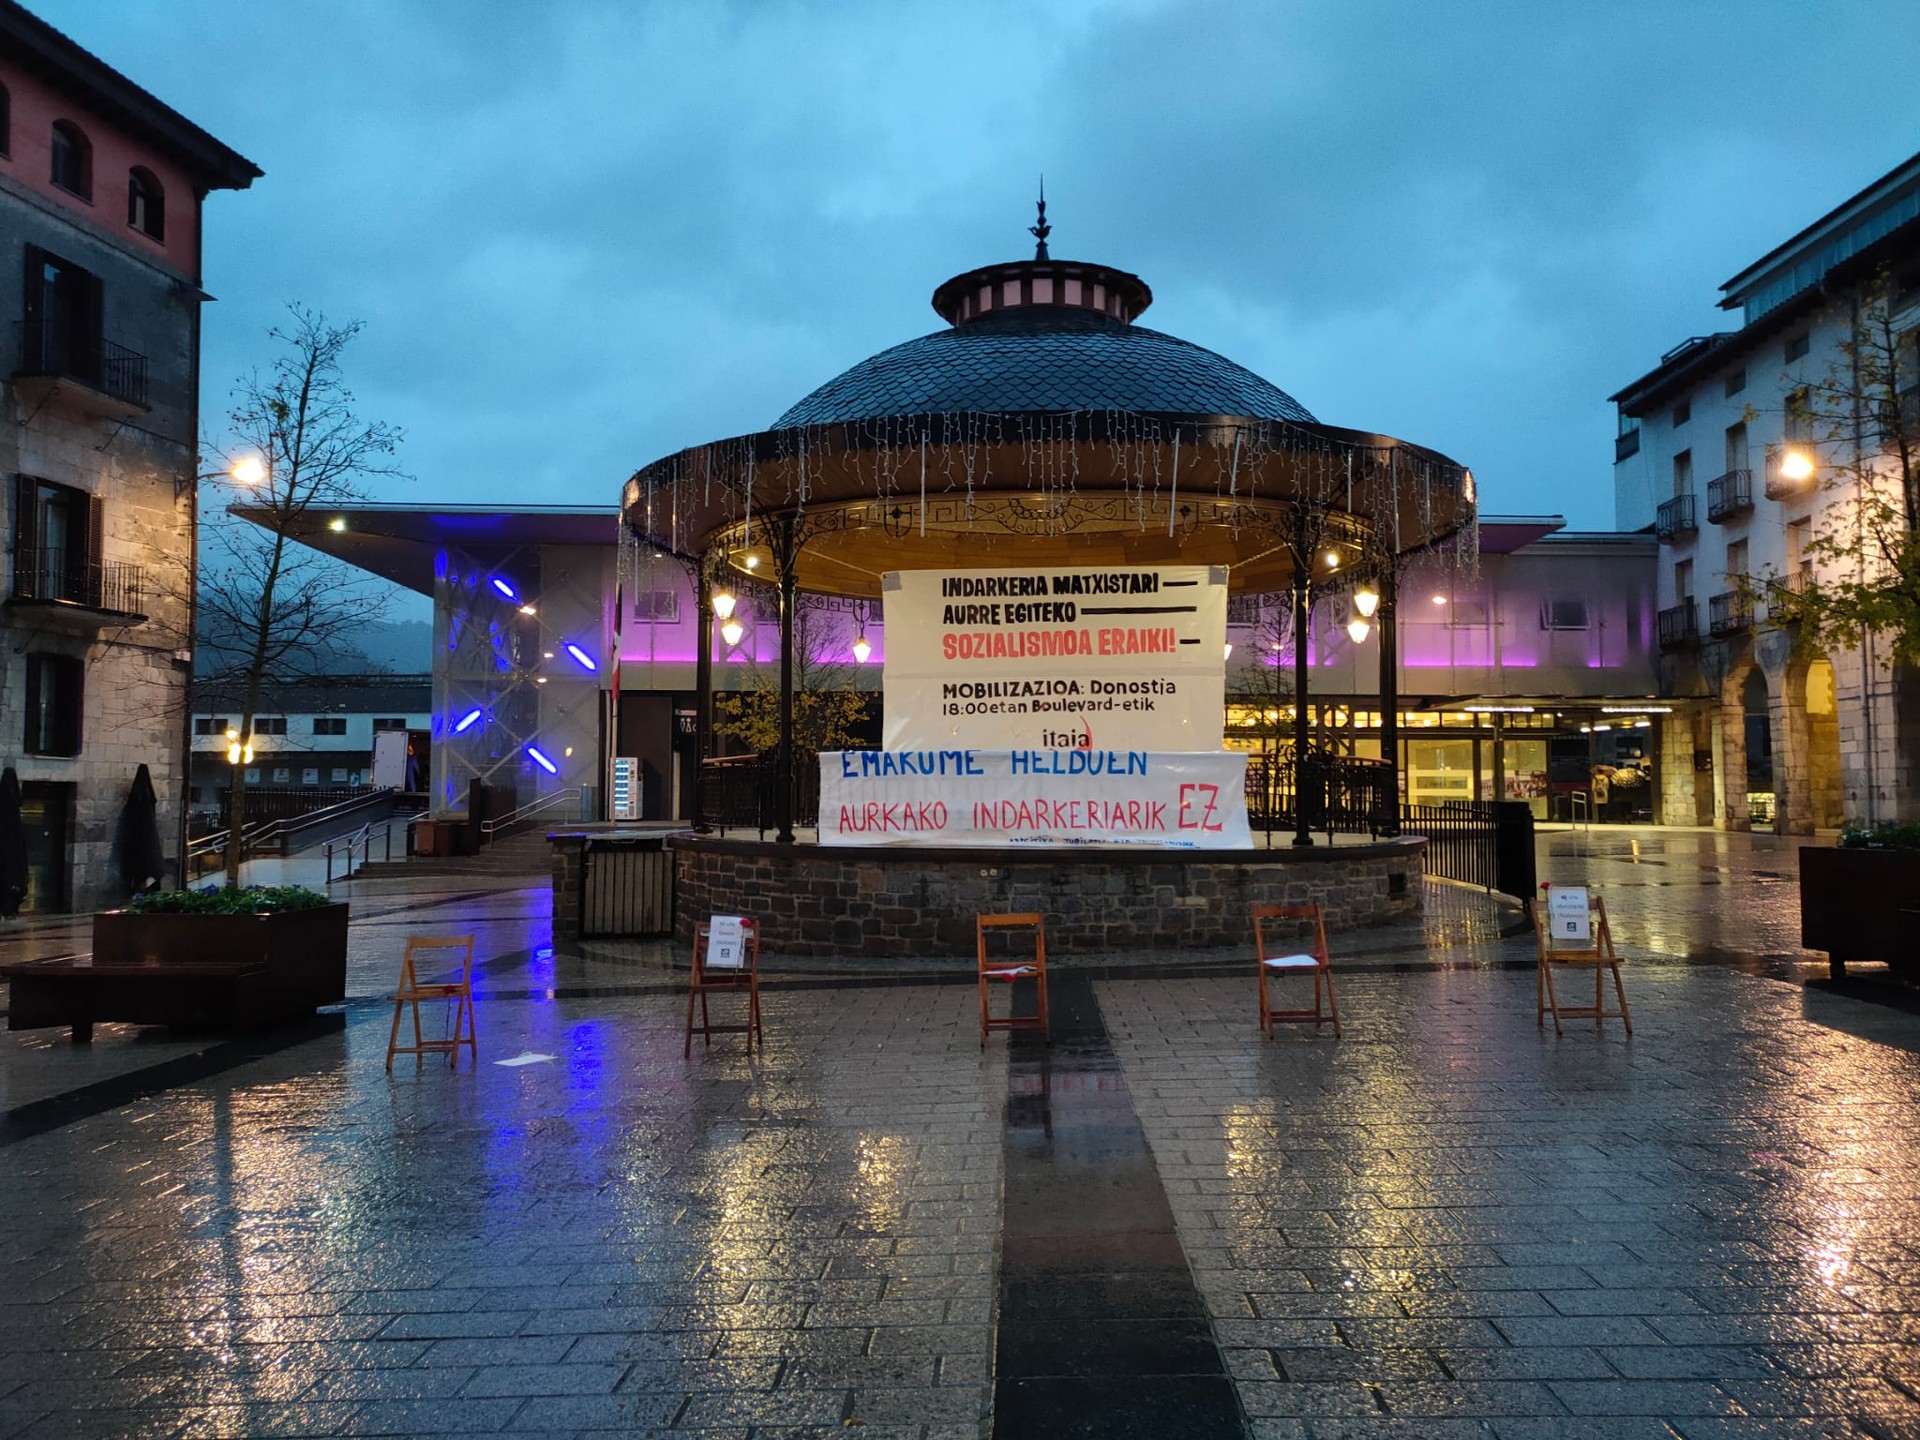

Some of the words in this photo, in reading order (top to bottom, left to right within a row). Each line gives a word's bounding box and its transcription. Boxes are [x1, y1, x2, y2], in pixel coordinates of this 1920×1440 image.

[942, 576, 1048, 598] INDARKERIA
[1052, 572, 1159, 595] MATXISTARI
[943, 603, 1000, 625] AURRE
[1005, 601, 1077, 624] EGITEKO
[942, 629, 1092, 660] SOZIALISMOA
[1098, 627, 1176, 656] ERAIKI!
[943, 679, 1085, 699] MOBILIZAZIOA:
[1090, 677, 1176, 696] Donostia
[943, 700, 1028, 715] 18:00etan
[1032, 697, 1155, 713] Boulevard-etik
[1042, 728, 1090, 748] itaia
[842, 749, 984, 778] EMAKUME
[1011, 750, 1148, 776] HELDUEN
[839, 800, 948, 833] AURKAKO
[974, 799, 1166, 830] INDARKERIARIK
[1179, 783, 1223, 832] EZ
